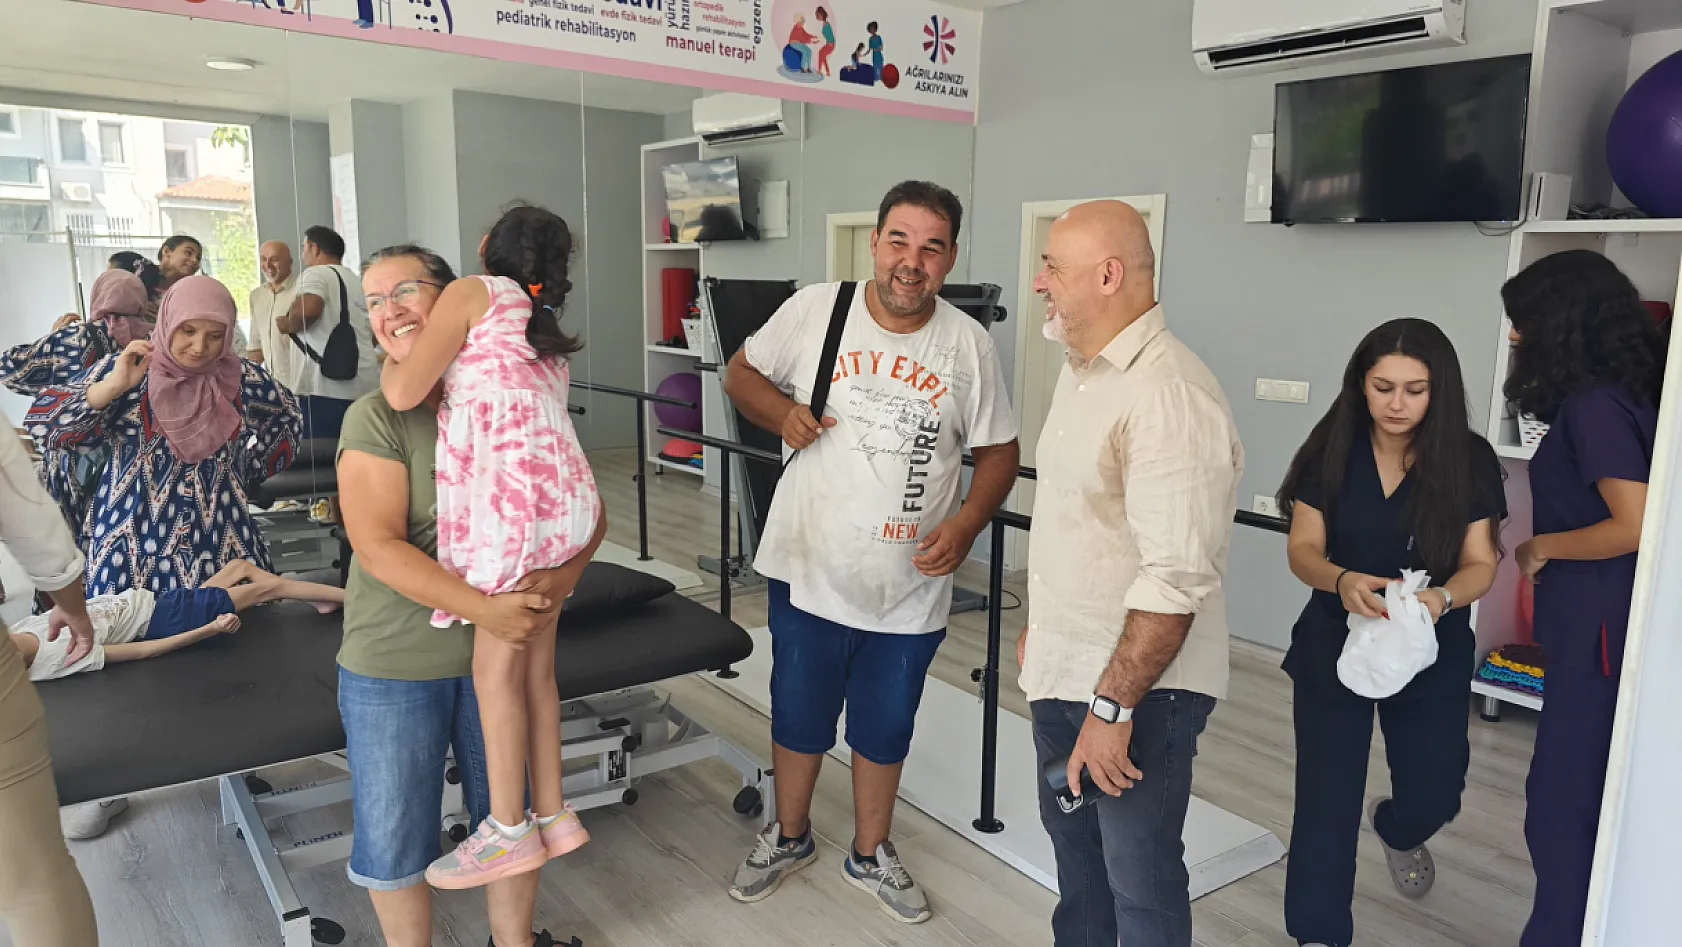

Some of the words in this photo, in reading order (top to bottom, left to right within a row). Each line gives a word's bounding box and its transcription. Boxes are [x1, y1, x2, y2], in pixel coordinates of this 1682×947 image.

[571, 3, 595, 15] tedavi
[601, 9, 619, 19] evde
[621, 10, 637, 22] fizik
[639, 14, 662, 26] tedavi
[496, 9, 552, 29] pediatrik
[555, 18, 636, 43] rehabilitasyon
[754, 0, 764, 44] egzer
[666, 36, 714, 54] manuel
[719, 42, 755, 63] terapi
[905, 64, 964, 85] AĞRILARINIZI
[914, 80, 946, 95] ASKIYA
[948, 86, 969, 99] ALIN
[902, 418, 941, 512] FUTURE
[882, 523, 919, 541] NEW
